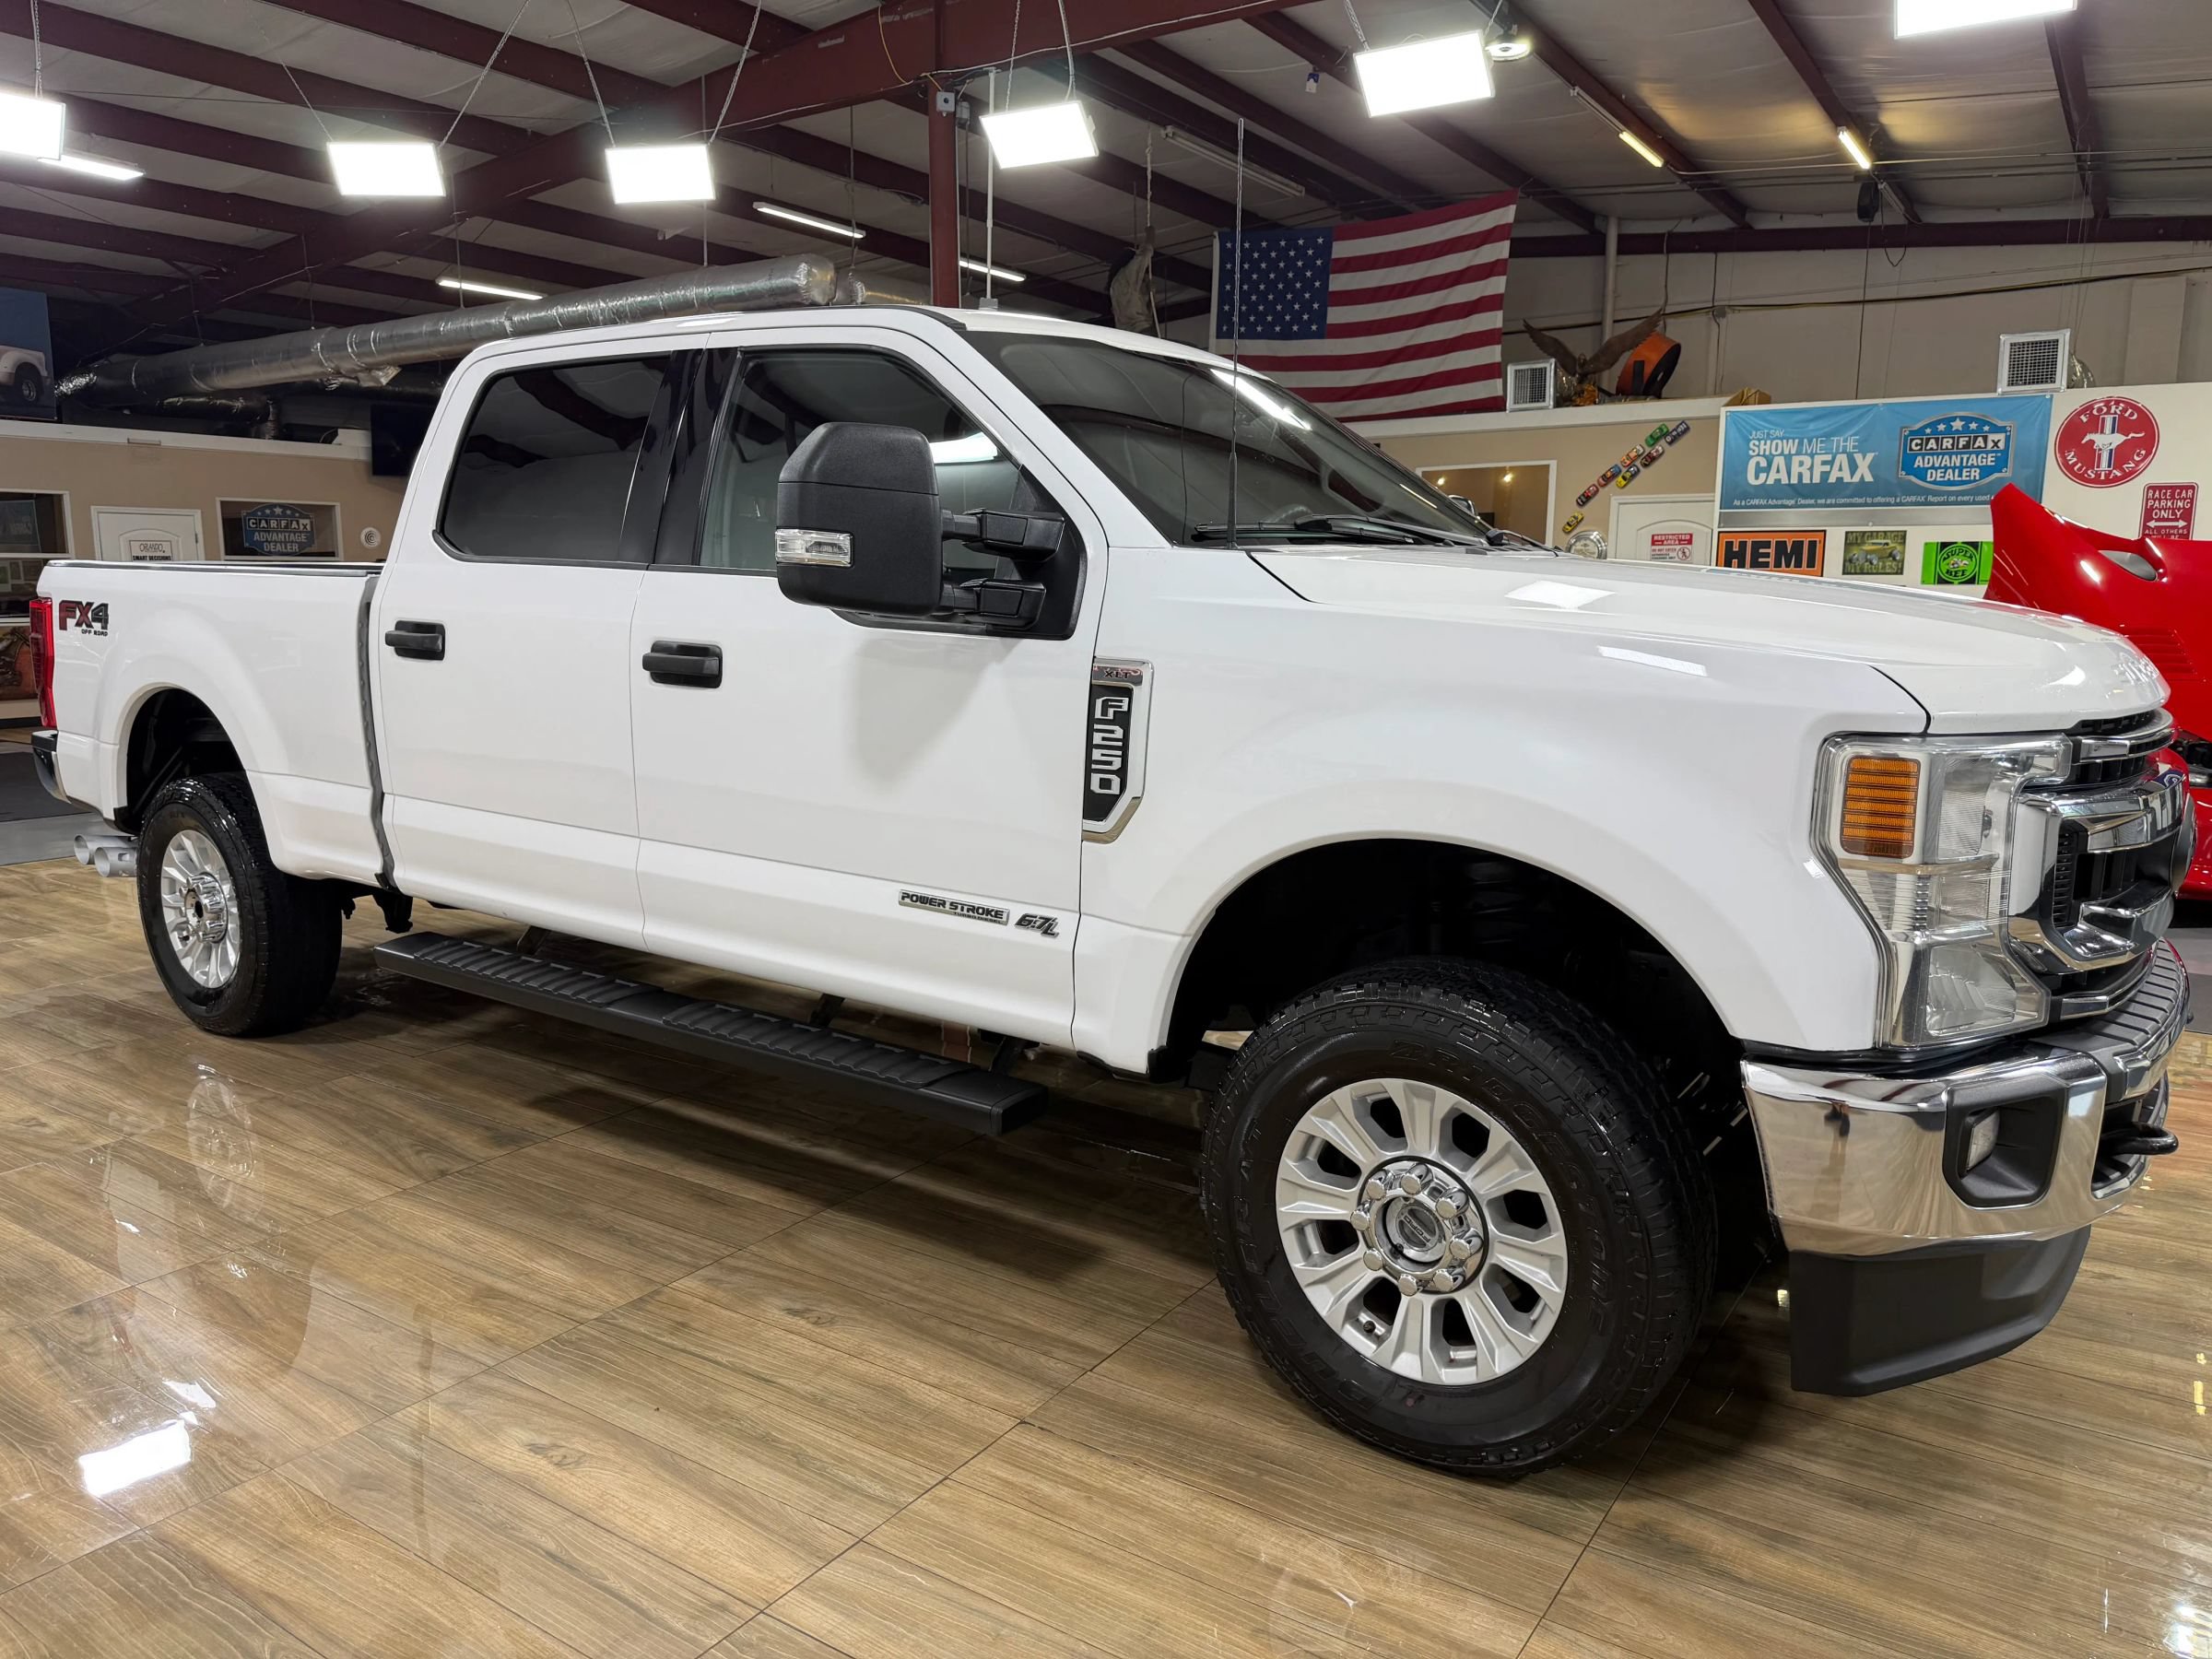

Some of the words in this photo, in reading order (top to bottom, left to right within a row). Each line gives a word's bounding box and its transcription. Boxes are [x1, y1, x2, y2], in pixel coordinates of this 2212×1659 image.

[2079, 401, 2138, 423] FORD
[1749, 430, 1767, 440] JUST
[1770, 429, 1784, 438] SAY
[1748, 439, 1798, 455] SHOW
[1802, 438, 1826, 453] ME
[1830, 436, 1859, 453] THE
[1911, 435, 2002, 451] CARFAX
[1913, 453, 1996, 468] ADVANTAGE
[2065, 448, 2147, 479] MUSTANG
[1747, 453, 1876, 485] CARFAX
[1927, 468, 1980, 481] DEALER
[2147, 489, 2171, 499] RACE
[2175, 489, 2193, 499] CAR
[2147, 500, 2191, 509] PARKING
[2152, 509, 2183, 519] ONLY
[249, 519, 308, 531] CARFAX
[253, 532, 307, 542] ADVANTAGE
[1846, 533, 1863, 544] MY
[1865, 532, 1904, 544] GARAGE
[264, 543, 299, 552] DEALER
[1724, 538, 1818, 570] HEMI
[1943, 548, 1973, 561] SUPER
[1844, 562, 1862, 573] MY
[1946, 569, 1968, 577] BEE
[59, 600, 109, 630] FX4
[1105, 670, 1129, 678] XLT
[1090, 697, 1129, 794] F250
[900, 892, 947, 908] POWER
[949, 901, 1005, 920] STROKE
[1403, 1215, 1430, 1243] FORD
